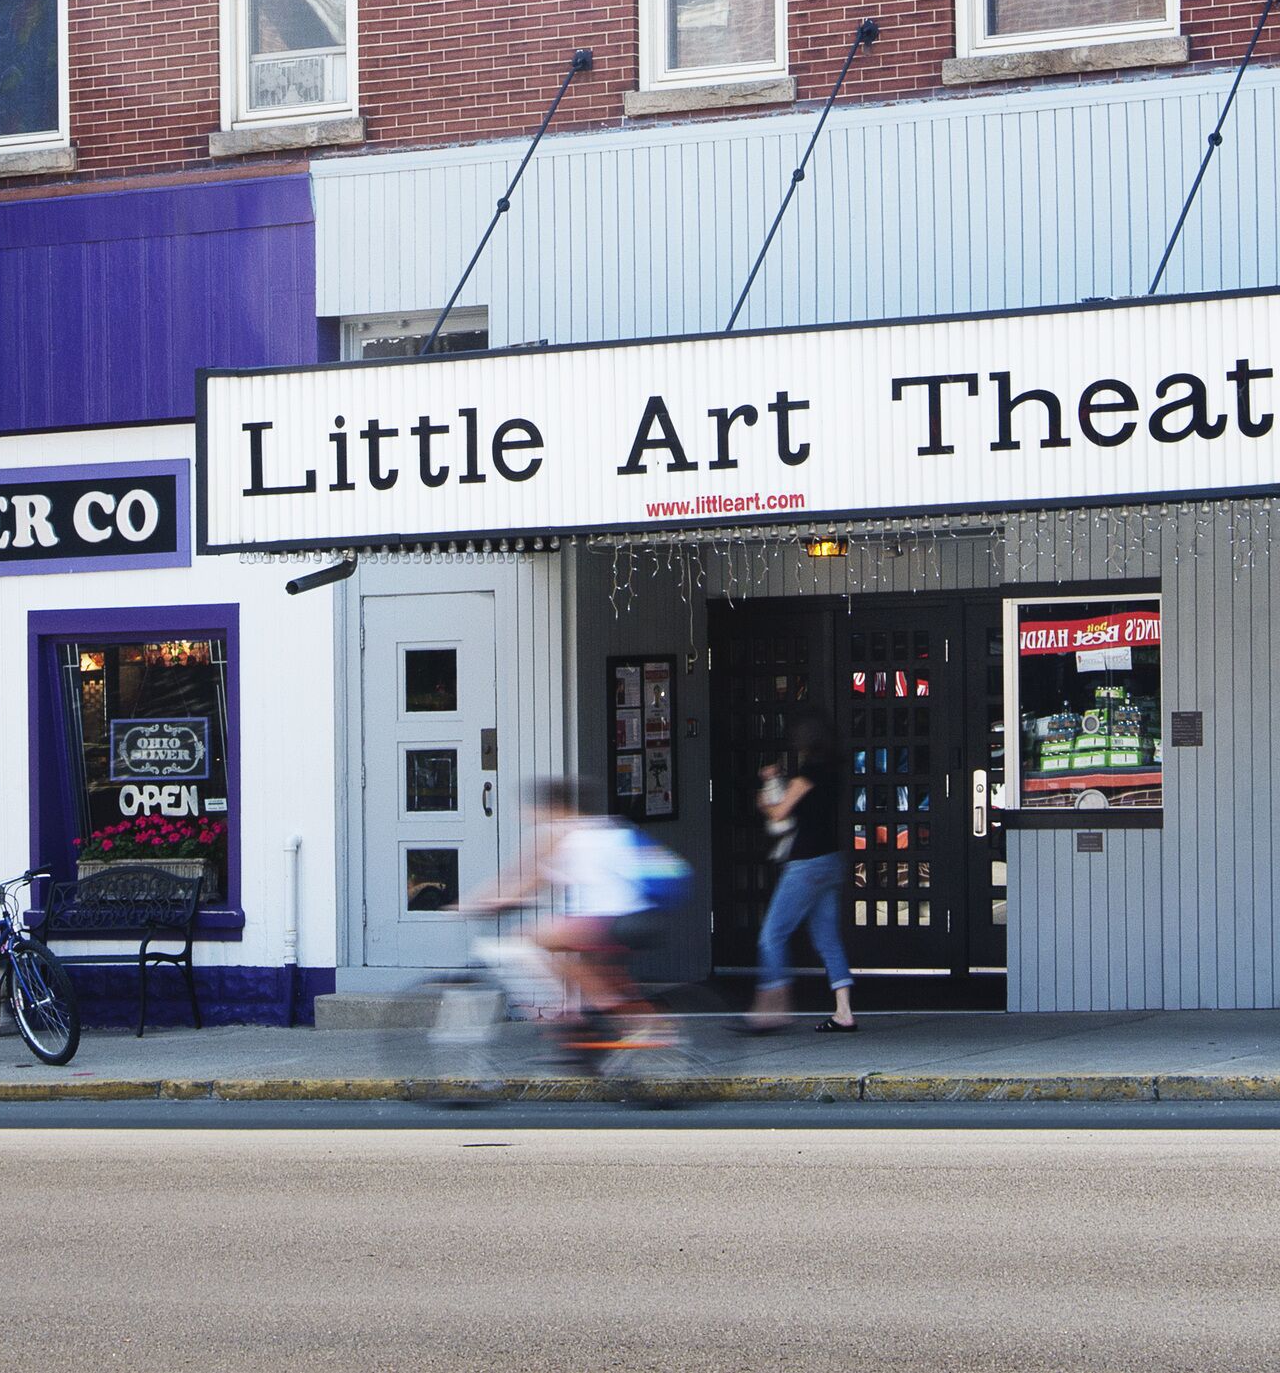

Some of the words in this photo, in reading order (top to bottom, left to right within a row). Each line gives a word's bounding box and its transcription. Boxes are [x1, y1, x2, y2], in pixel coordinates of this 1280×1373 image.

[241, 407, 544, 497] Little
[616, 390, 811, 476] Art
[72, 488, 161, 543] CO
[646, 493, 805, 517] www.littleart.com
[130, 749, 191, 760] SILVER
[137, 738, 180, 749] OHIO
[119, 784, 199, 816] OPEN
